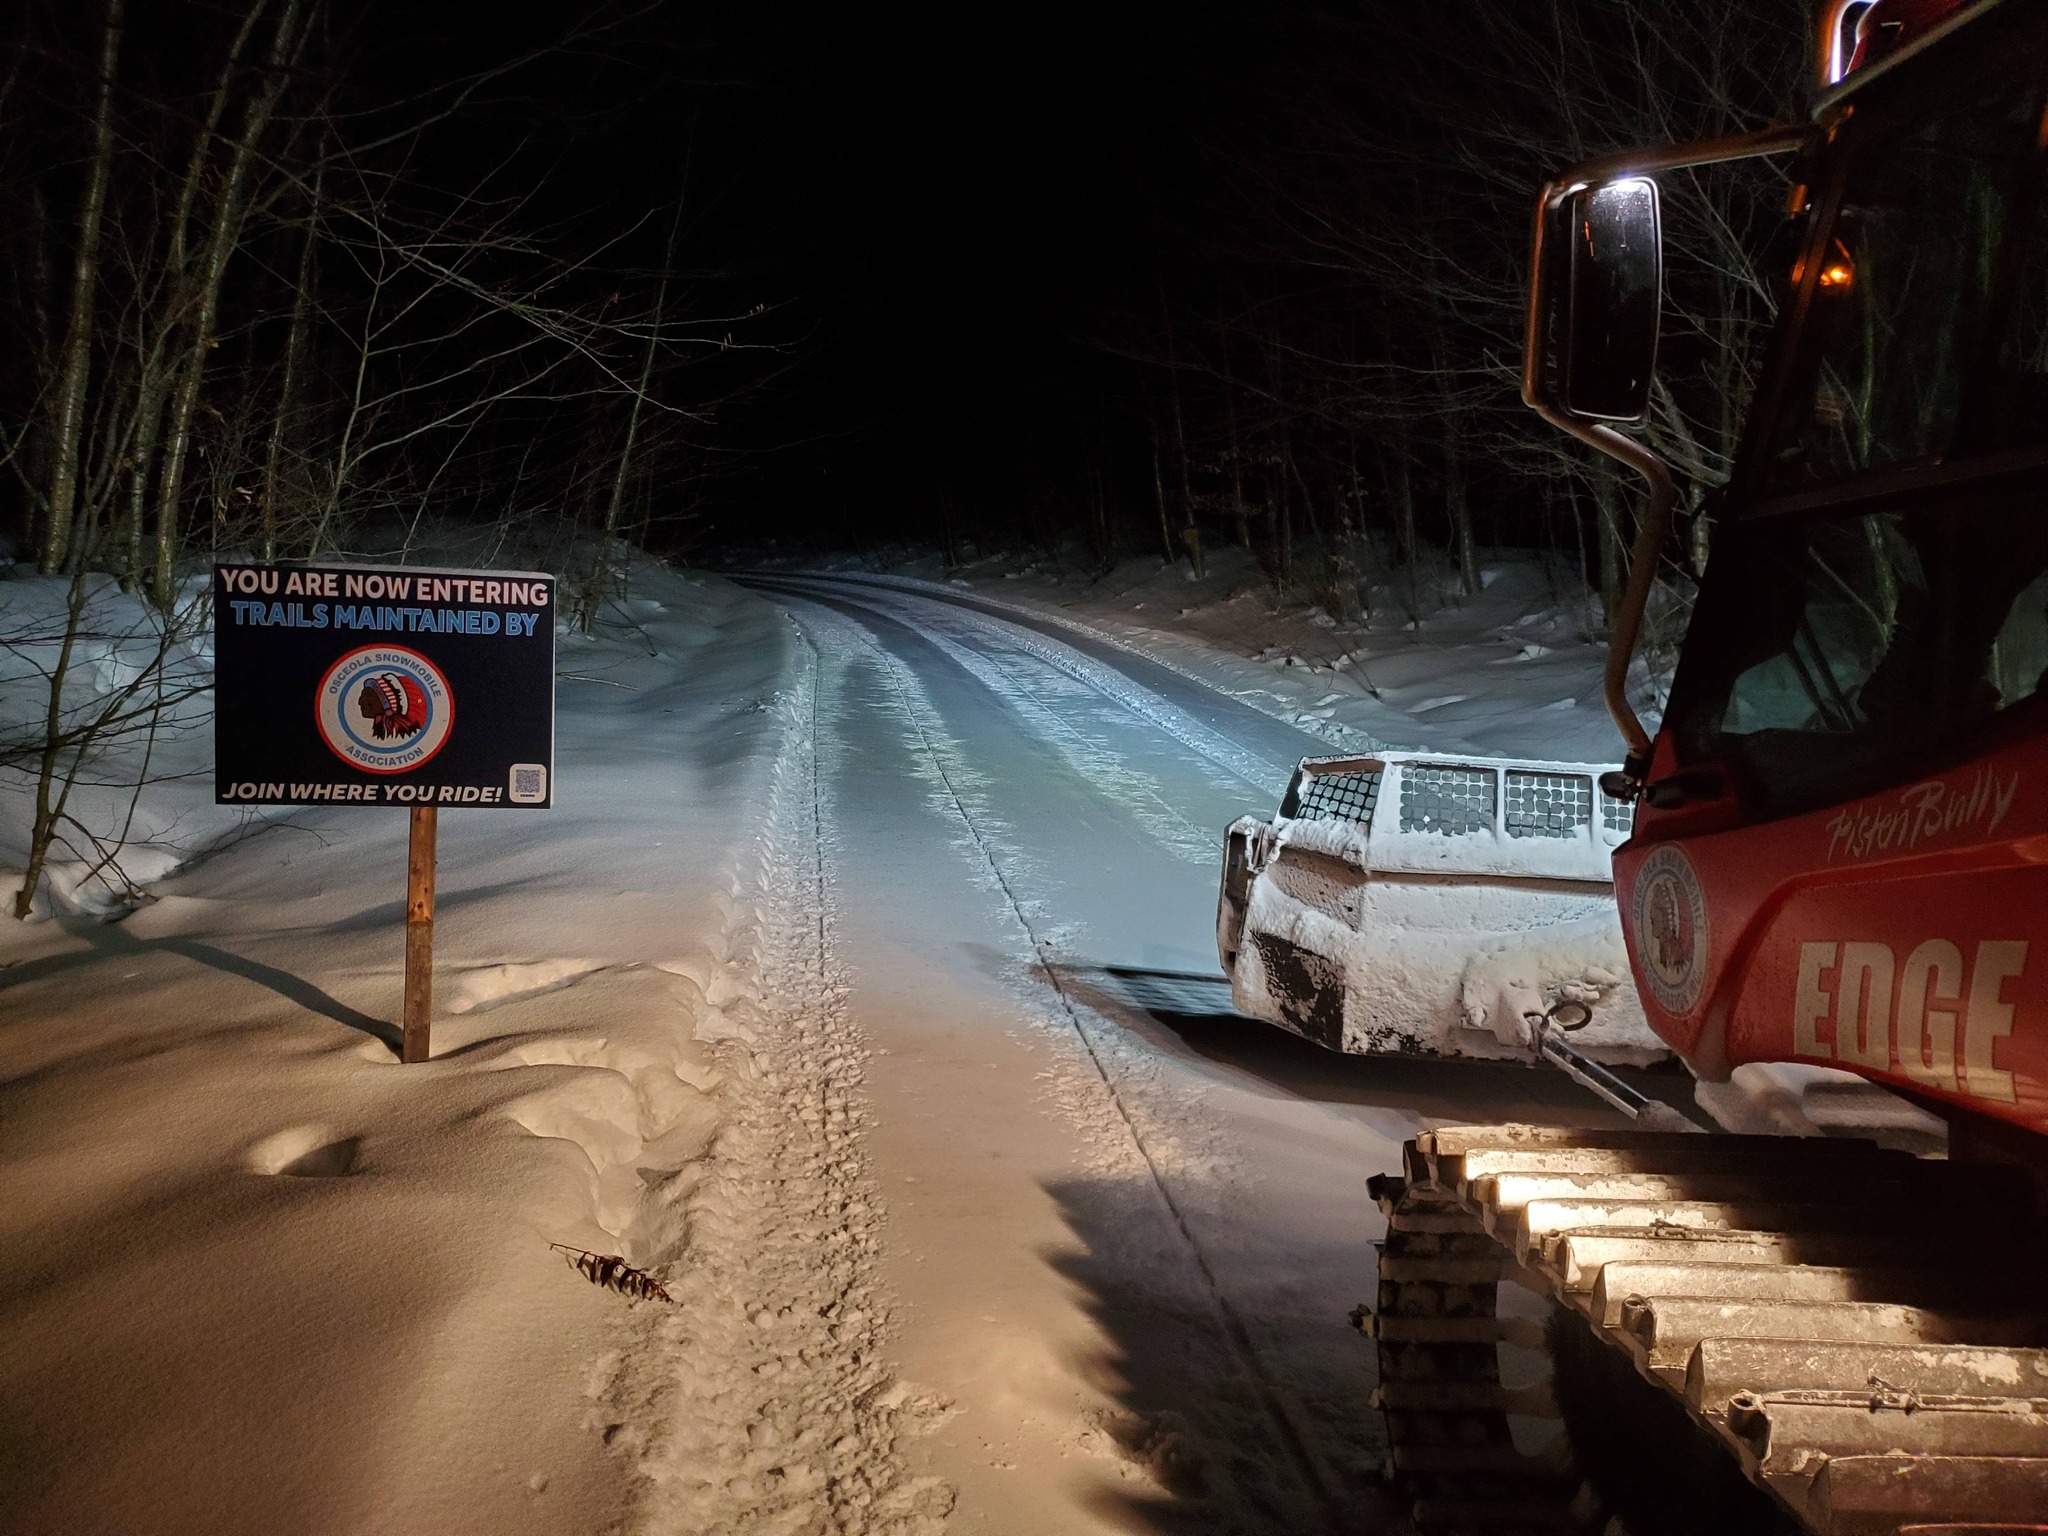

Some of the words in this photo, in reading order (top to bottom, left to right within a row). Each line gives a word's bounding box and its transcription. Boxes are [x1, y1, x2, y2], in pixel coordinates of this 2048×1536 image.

[220, 568, 279, 594] YOU
[285, 572, 339, 597] ARE
[345, 574, 411, 599] NOW
[416, 578, 548, 606] ENTERING
[230, 600, 329, 629] TRAILS
[334, 604, 501, 635] MAINTAINED
[505, 612, 540, 636] BY
[329, 655, 372, 694] OSCEOLA
[375, 653, 441, 698] SNOWMOBILE
[345, 745, 424, 767] ASSOCIATION
[222, 782, 285, 800] JOIN
[289, 783, 379, 801] WHERE
[384, 784, 434, 802] YOU
[438, 785, 504, 803] RIDE!
[1793, 938, 2030, 1104] EDGE
